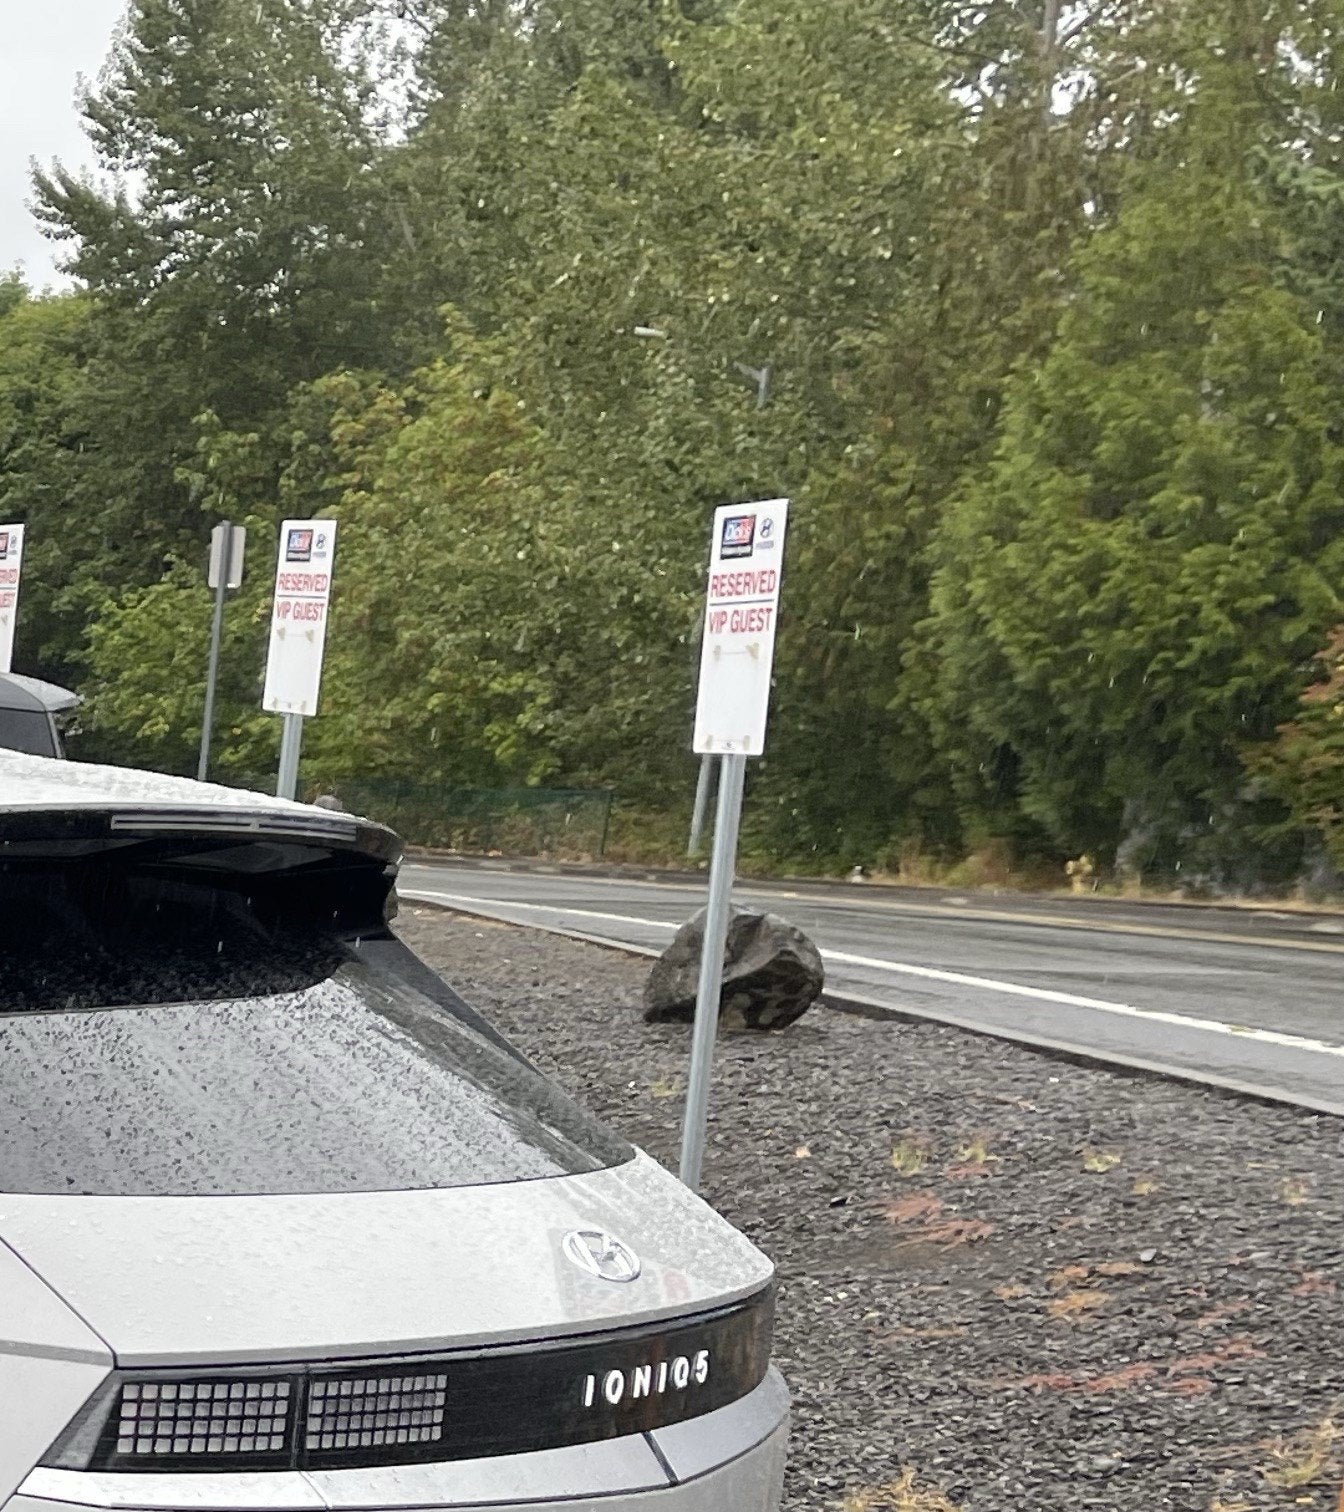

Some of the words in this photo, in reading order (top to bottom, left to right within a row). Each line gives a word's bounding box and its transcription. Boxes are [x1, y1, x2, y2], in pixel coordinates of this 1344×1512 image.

[278, 573, 328, 592] RESERVED
[710, 569, 776, 598] RESERVED
[276, 601, 291, 620] VIP
[293, 601, 325, 622] GUEST
[709, 611, 727, 634] VIP
[730, 607, 773, 633] GUEST
